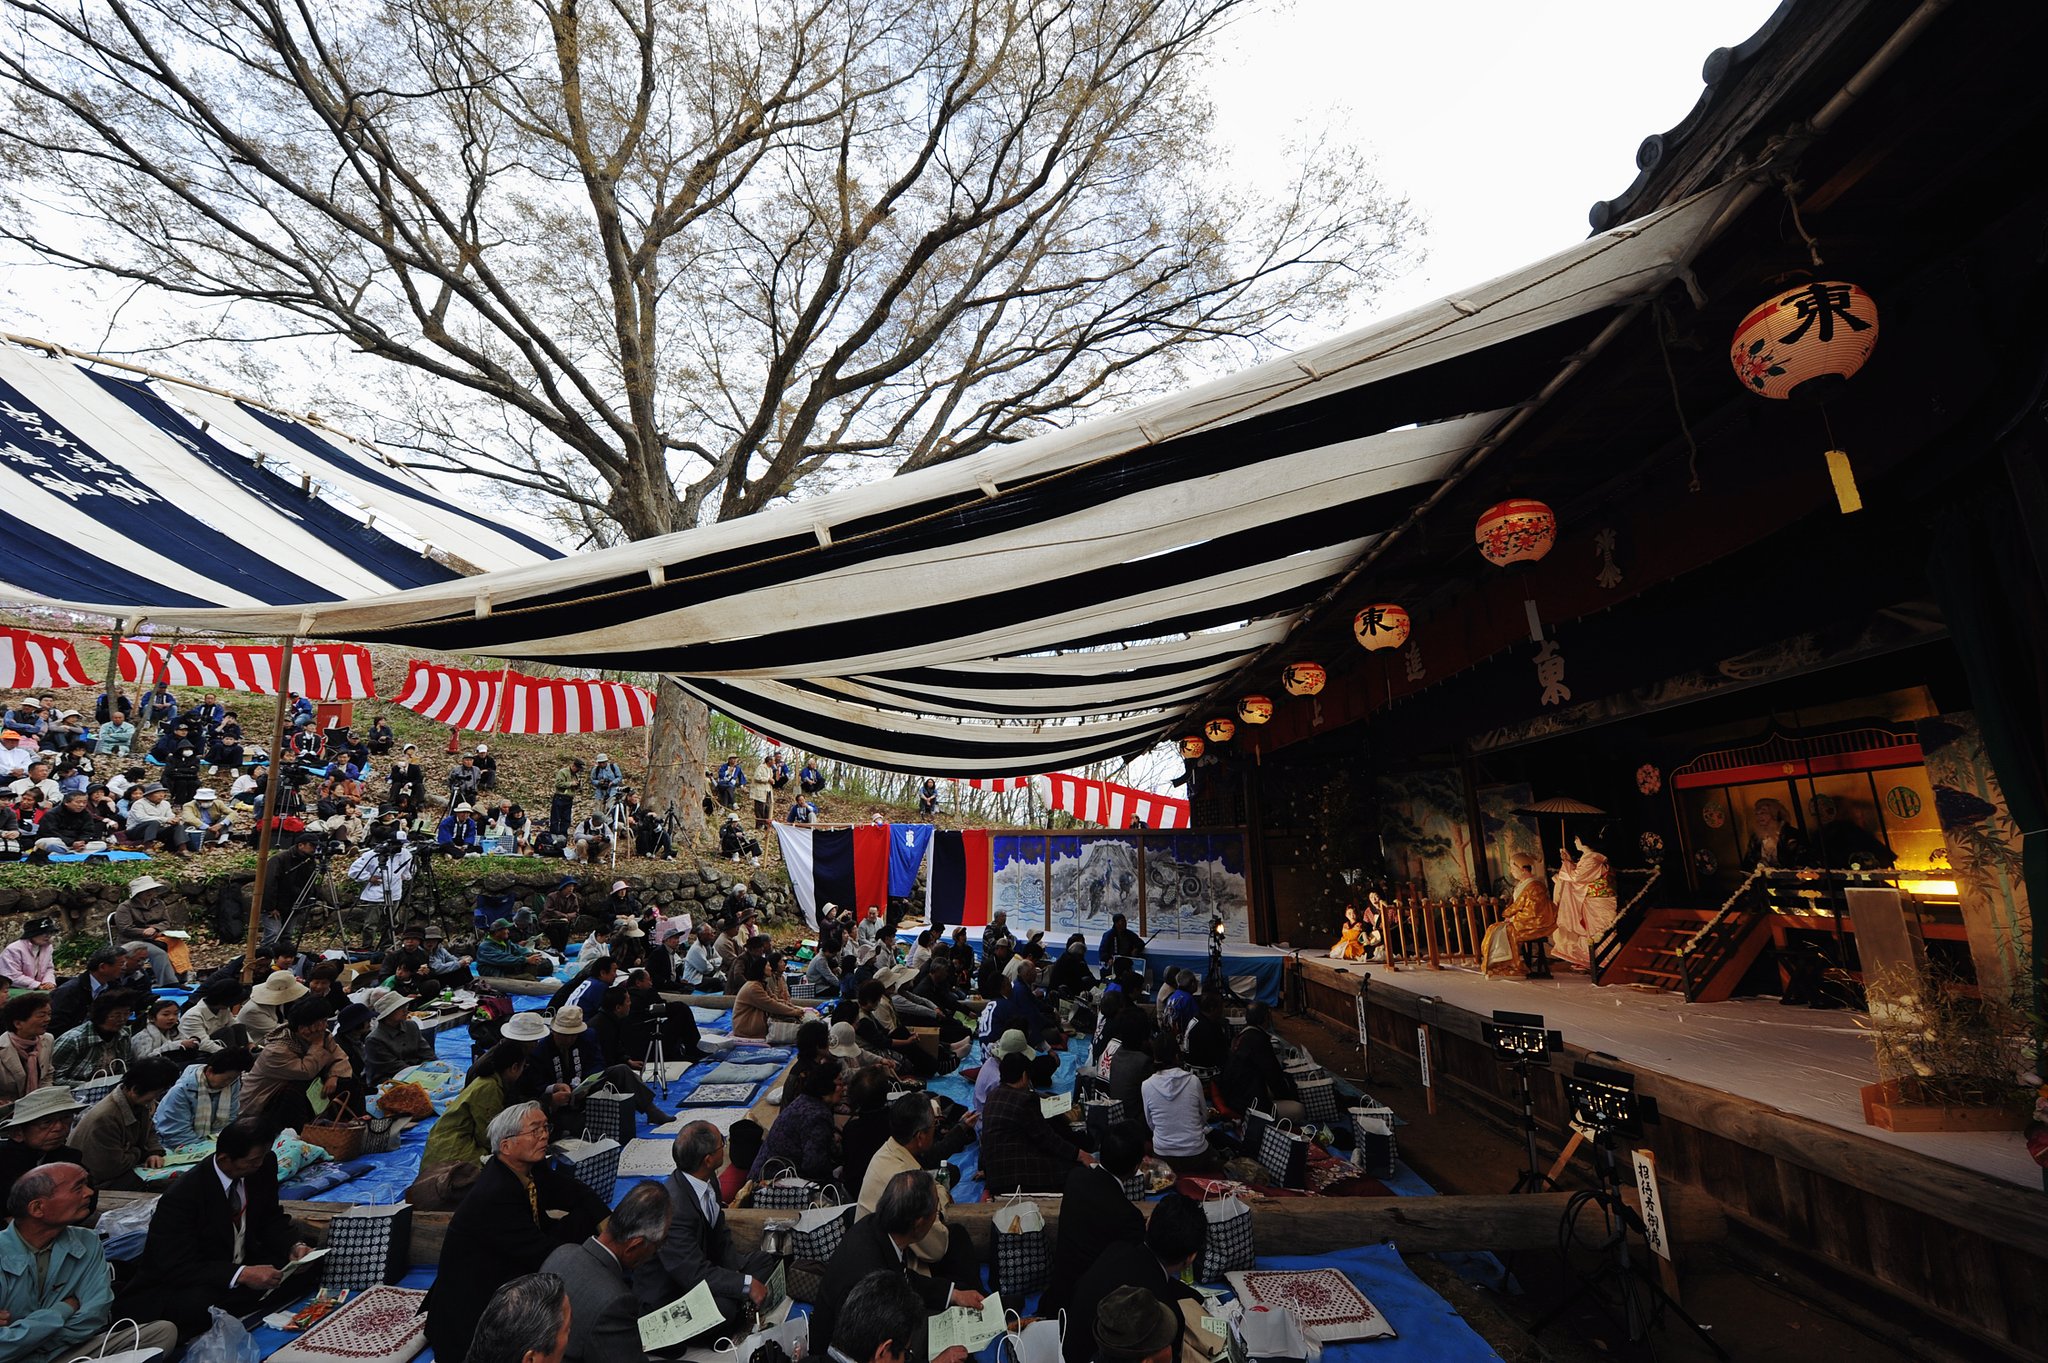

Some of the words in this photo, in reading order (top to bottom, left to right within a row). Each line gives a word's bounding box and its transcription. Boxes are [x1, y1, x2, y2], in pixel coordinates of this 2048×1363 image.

[1778, 283, 1873, 344] 東
[1360, 608, 1395, 636] 東
[1282, 667, 1306, 688] 東
[1208, 721, 1227, 736] 東
